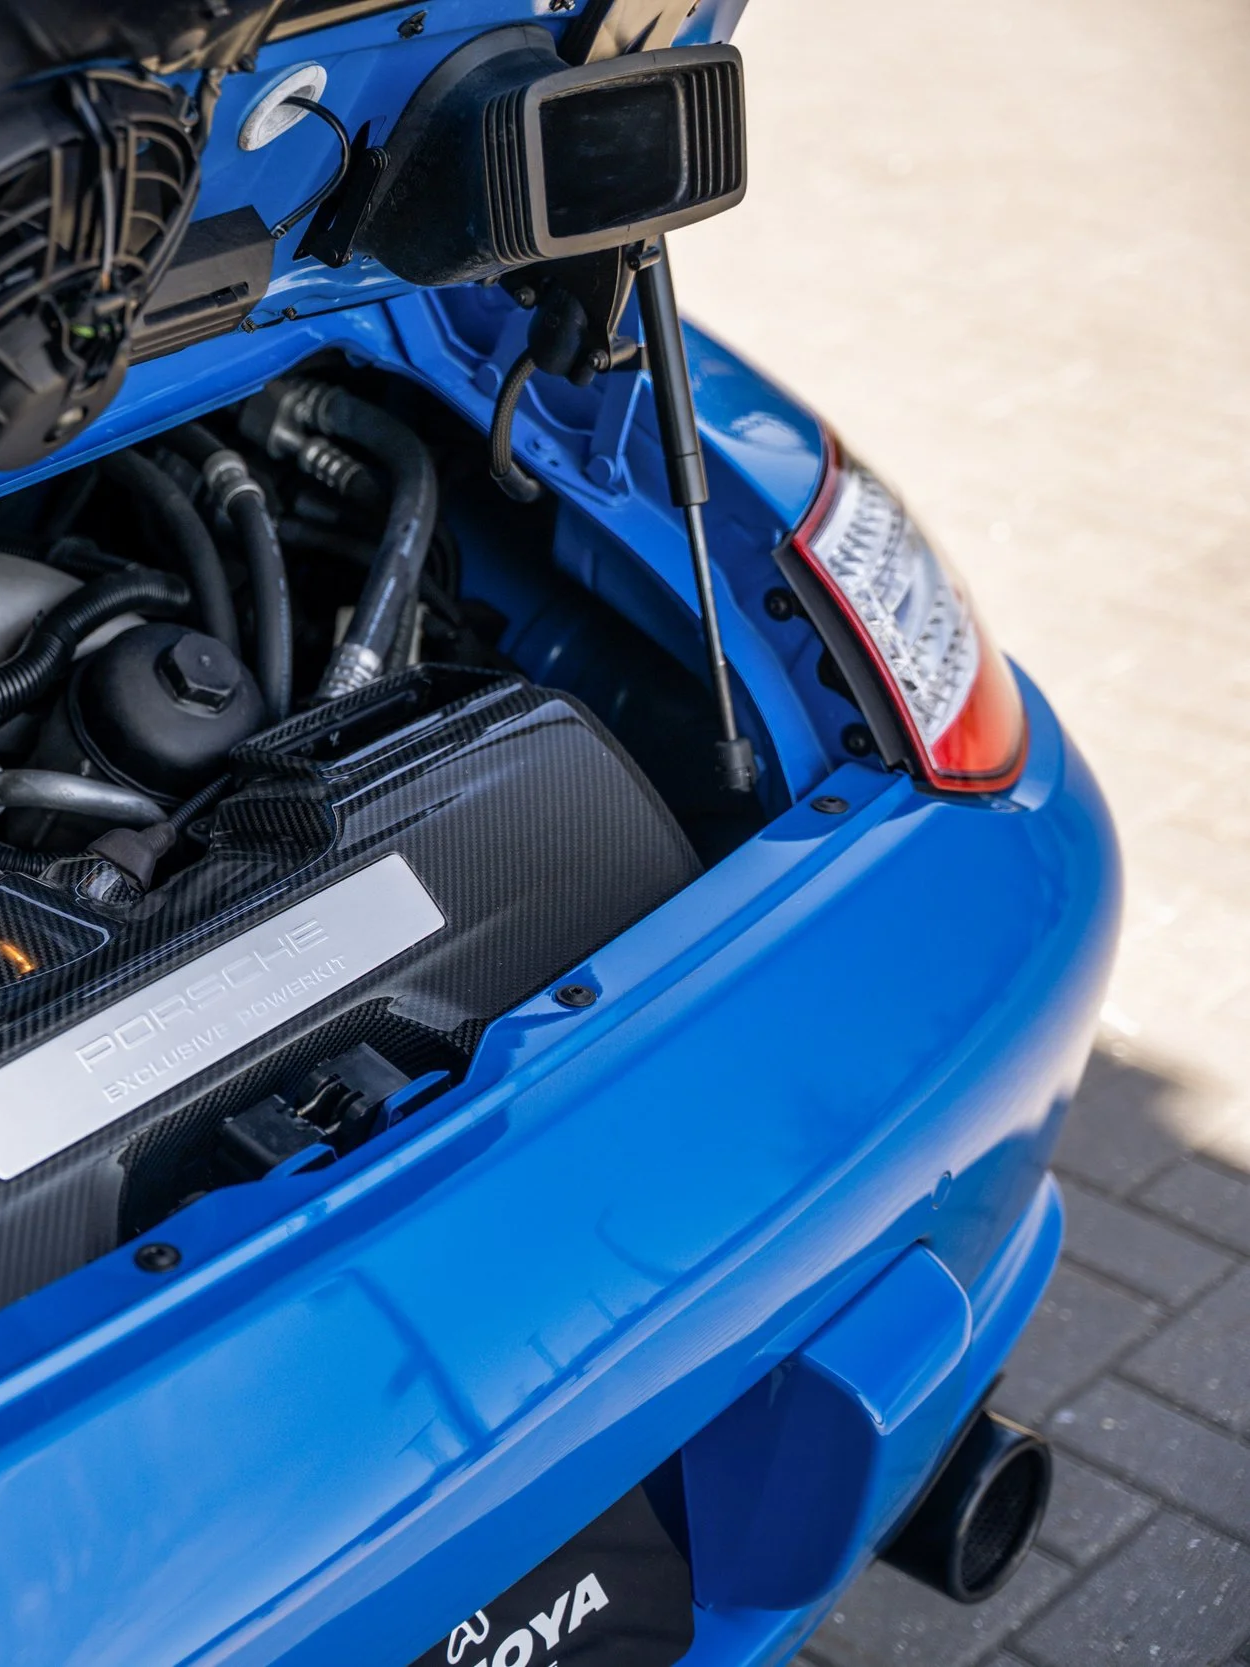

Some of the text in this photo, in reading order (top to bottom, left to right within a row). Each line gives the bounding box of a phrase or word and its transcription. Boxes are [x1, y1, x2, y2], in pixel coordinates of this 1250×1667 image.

[75, 918, 329, 1074] PORSCHE
[102, 955, 347, 1104] EXCLUSIVE POWERKIT
[474, 1573, 609, 1667] OYA
